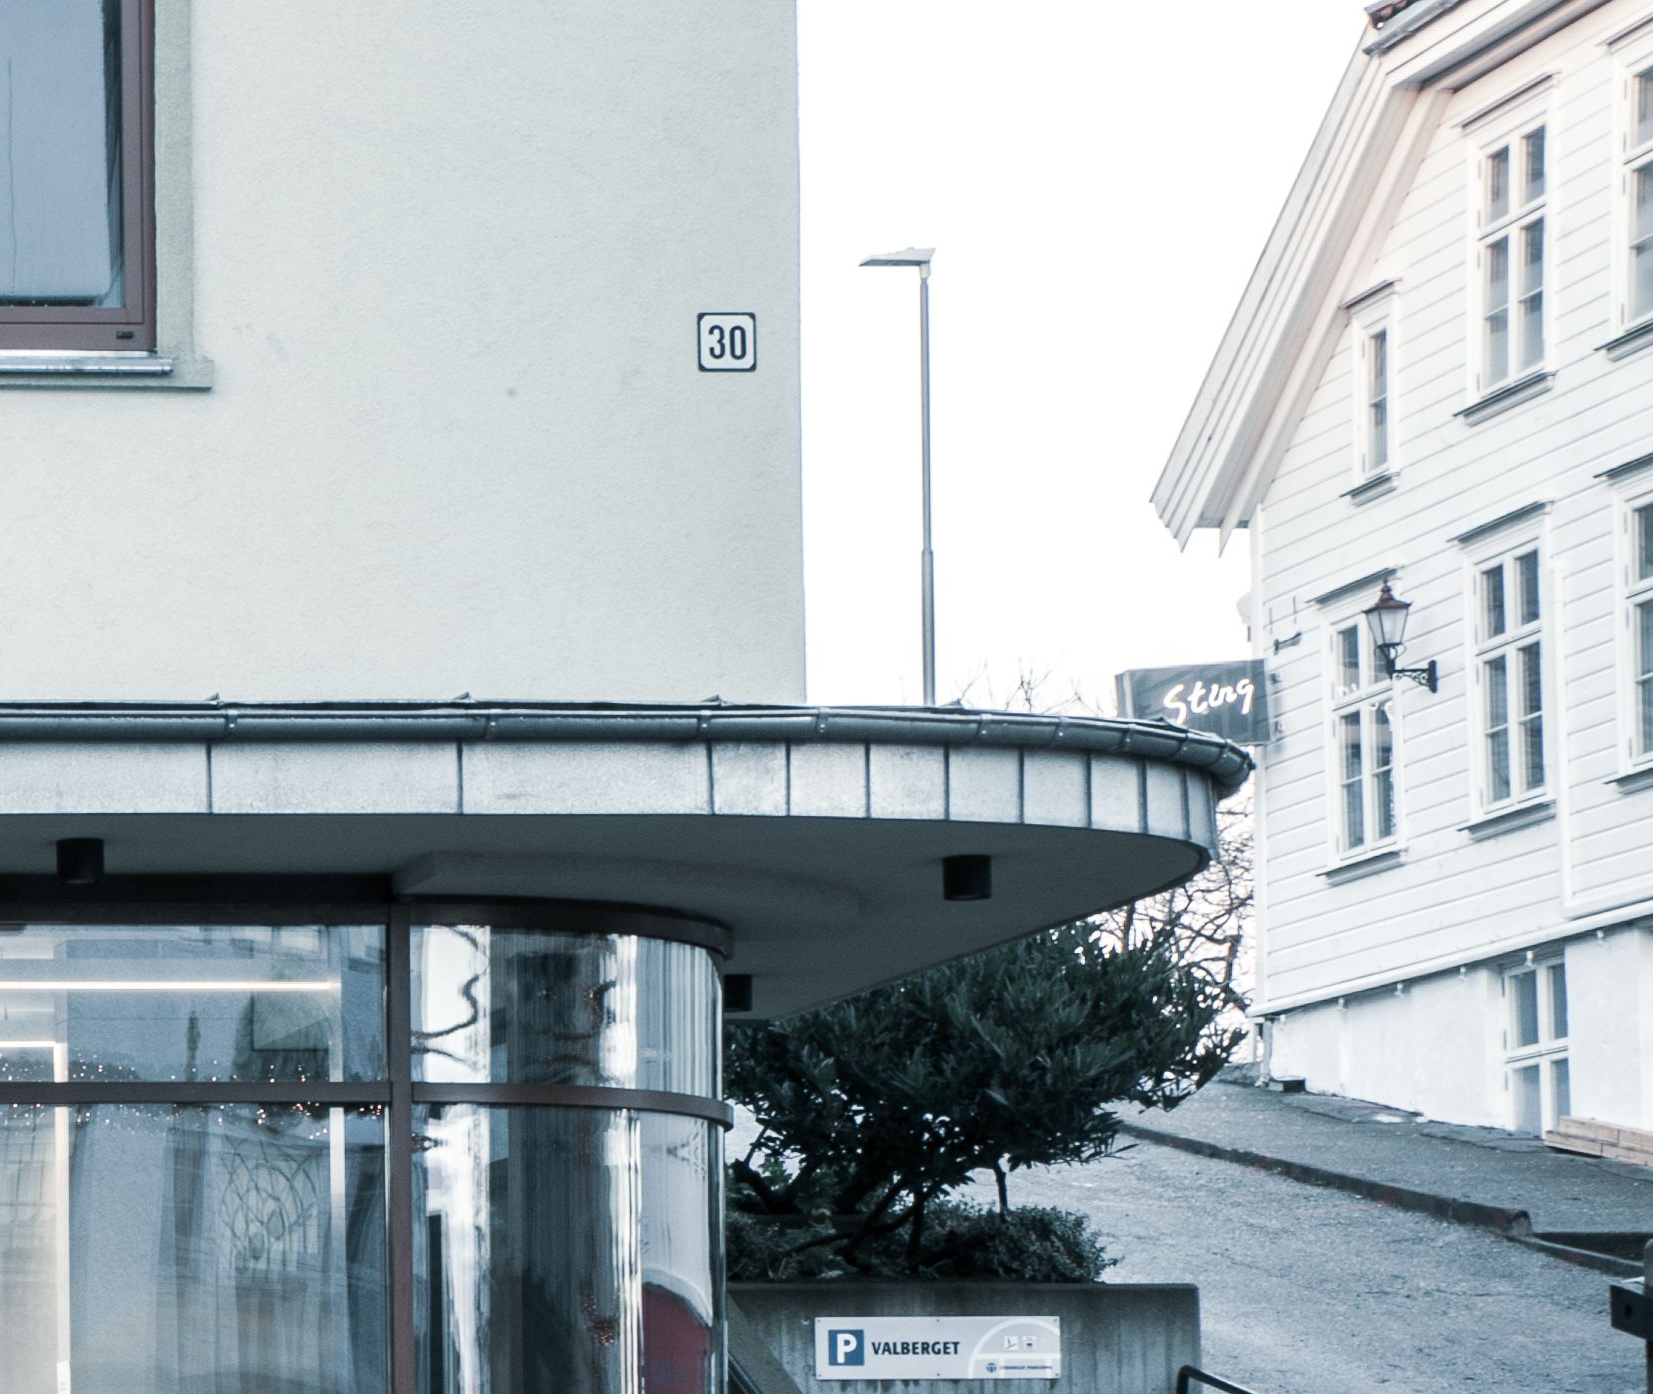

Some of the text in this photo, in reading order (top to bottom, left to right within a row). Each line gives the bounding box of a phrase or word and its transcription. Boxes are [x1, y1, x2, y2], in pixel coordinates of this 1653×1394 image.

[708, 324, 747, 361] 30
[1163, 678, 1255, 725] Sting
[836, 1333, 960, 1364] P VALBERGET
